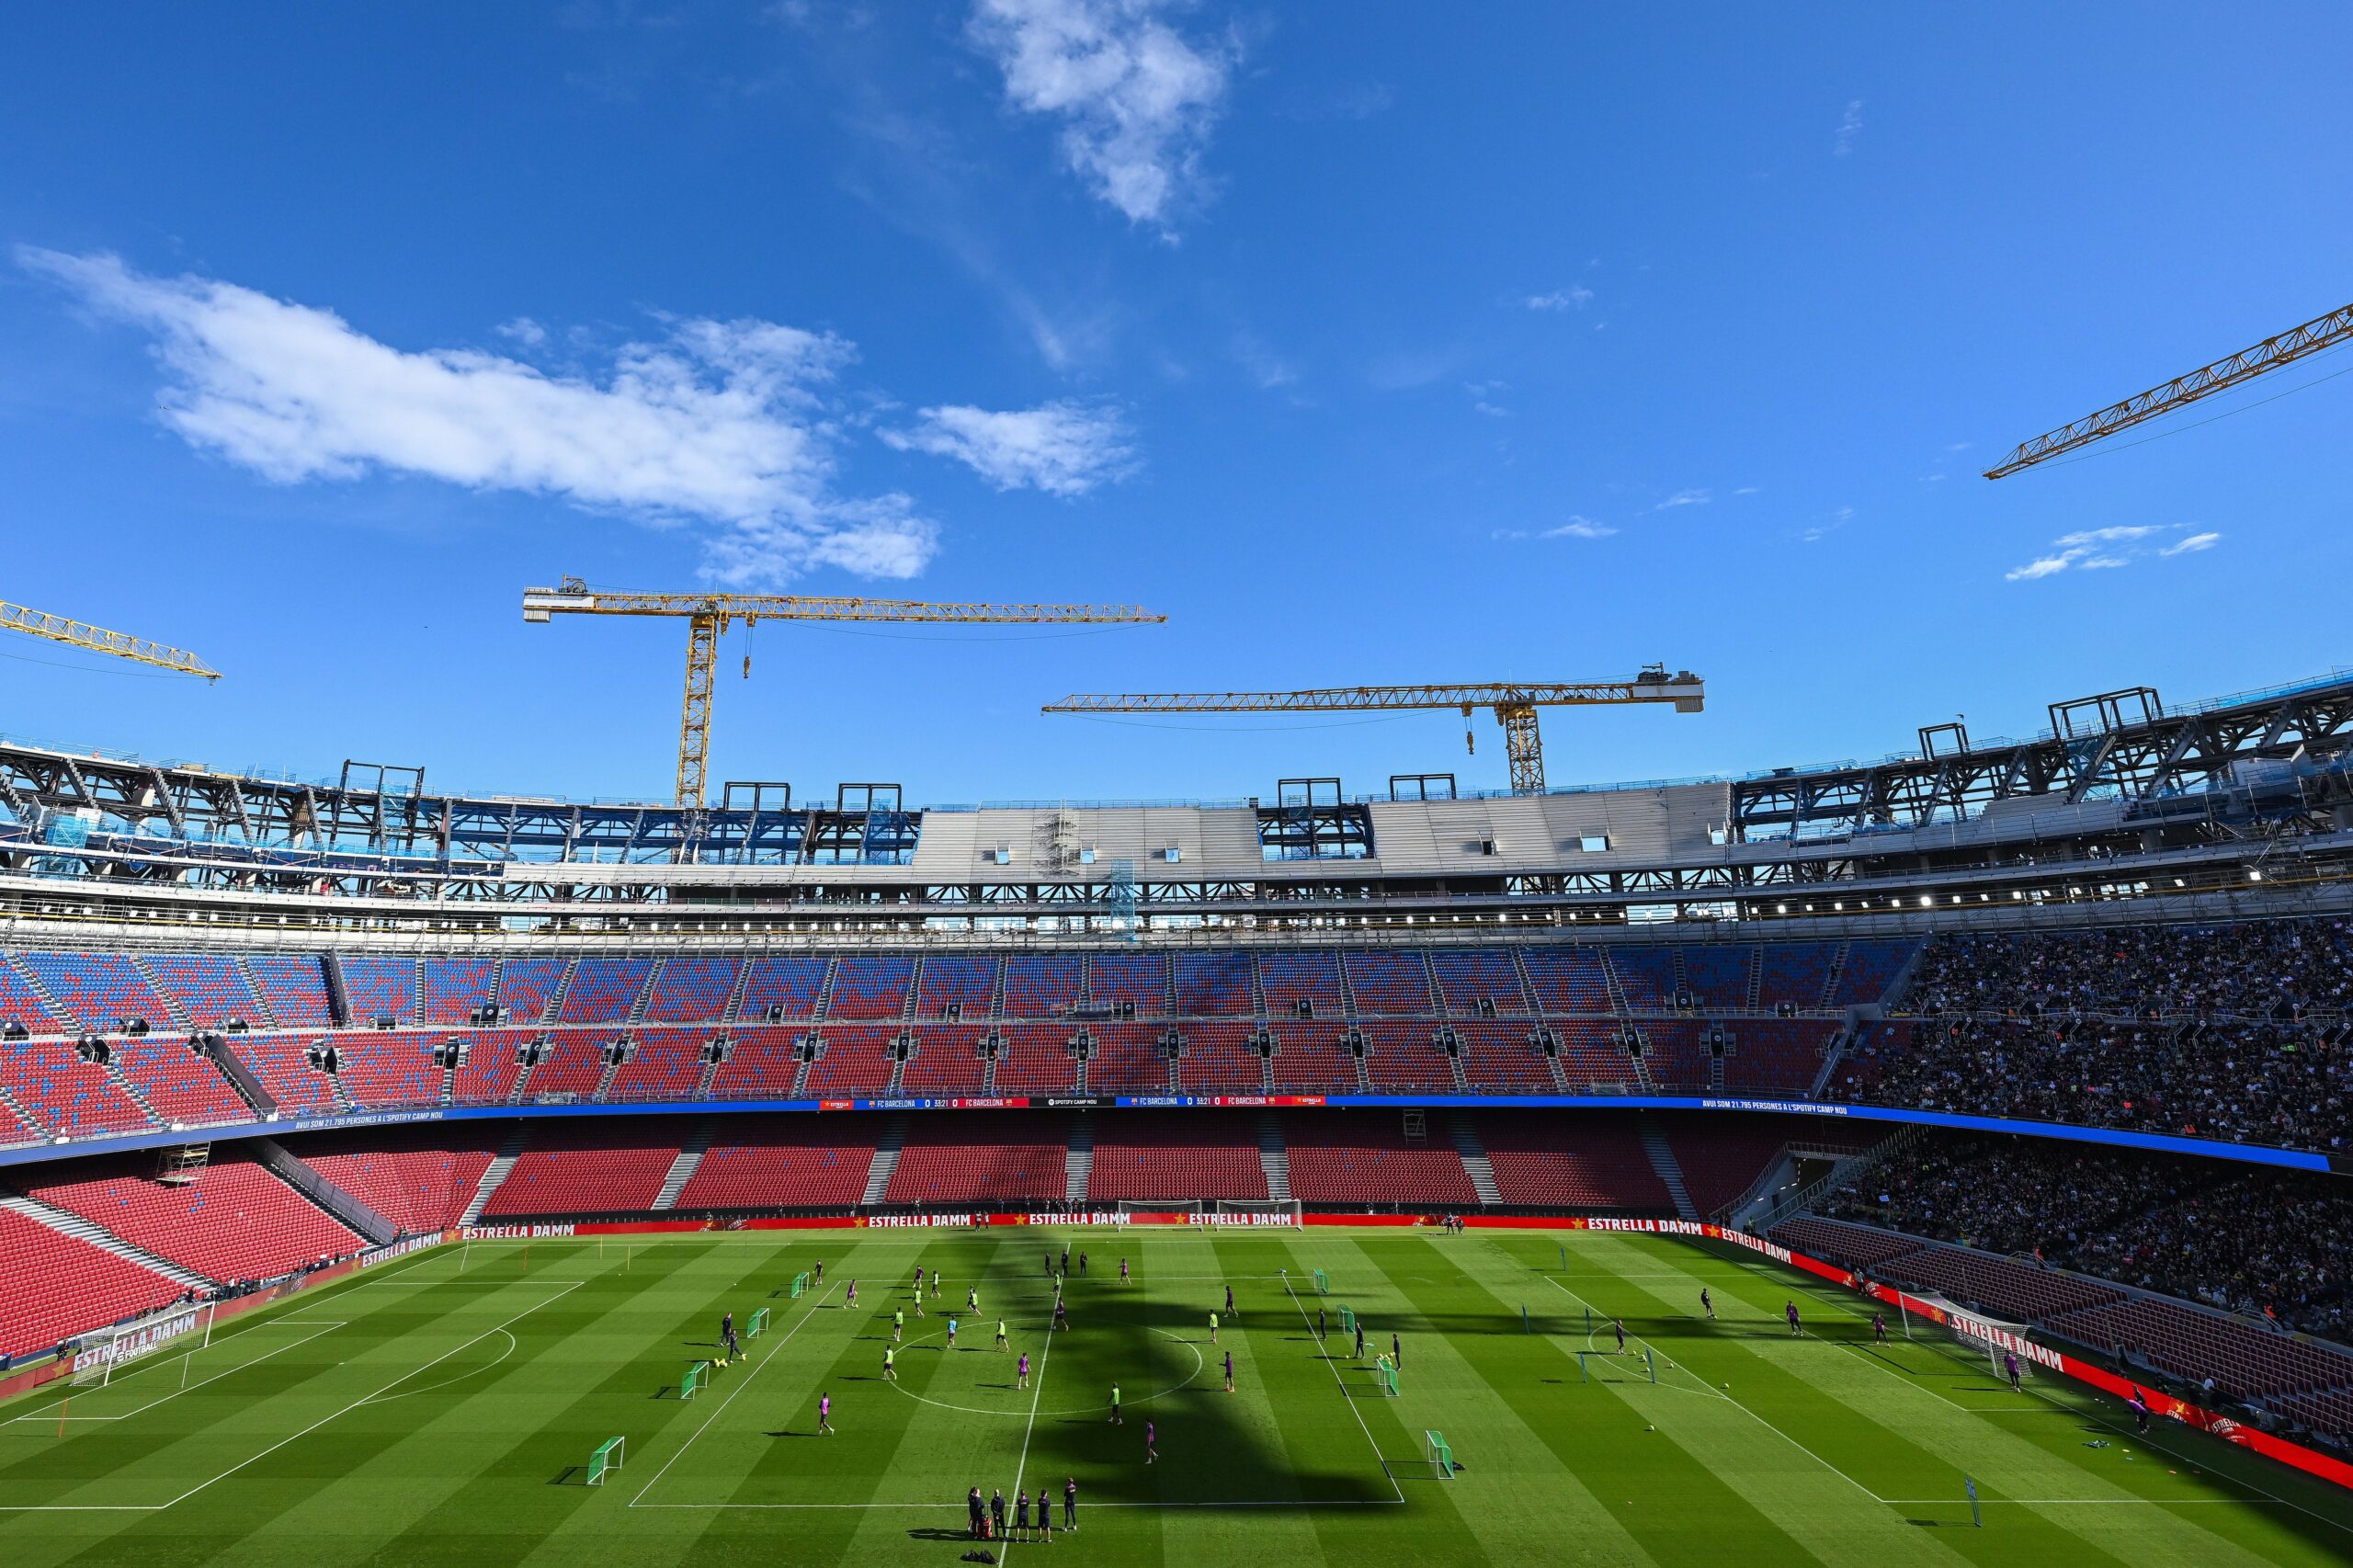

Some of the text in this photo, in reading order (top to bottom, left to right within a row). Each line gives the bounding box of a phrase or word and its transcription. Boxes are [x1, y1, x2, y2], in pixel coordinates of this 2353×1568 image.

[1788, 1104, 1816, 1112] L'SPOTIFY
[296, 1121, 310, 1129] AVUI
[310, 1119, 323, 1128] SOM
[325, 1118, 345, 1127] 21.795
[346, 1116, 376, 1124] PERSONES
[383, 1113, 411, 1122] L'SPOTIFY
[869, 1215, 971, 1227] ESTRELLA DAMM
[1029, 1213, 1130, 1225] ESTRELLA DAMM
[1189, 1214, 1291, 1225] ESTRELLA DAMM
[1588, 1218, 1703, 1236] ESTRELLA DAMM
[462, 1225, 574, 1240] ESTRELLA DAMM
[363, 1232, 442, 1268] ESTRELLA DAMM
[1721, 1228, 1792, 1264] ESTRELLA DAMM
[152, 1314, 196, 1341] DAMM
[1949, 1315, 2064, 1372] STRELLA DAMM
